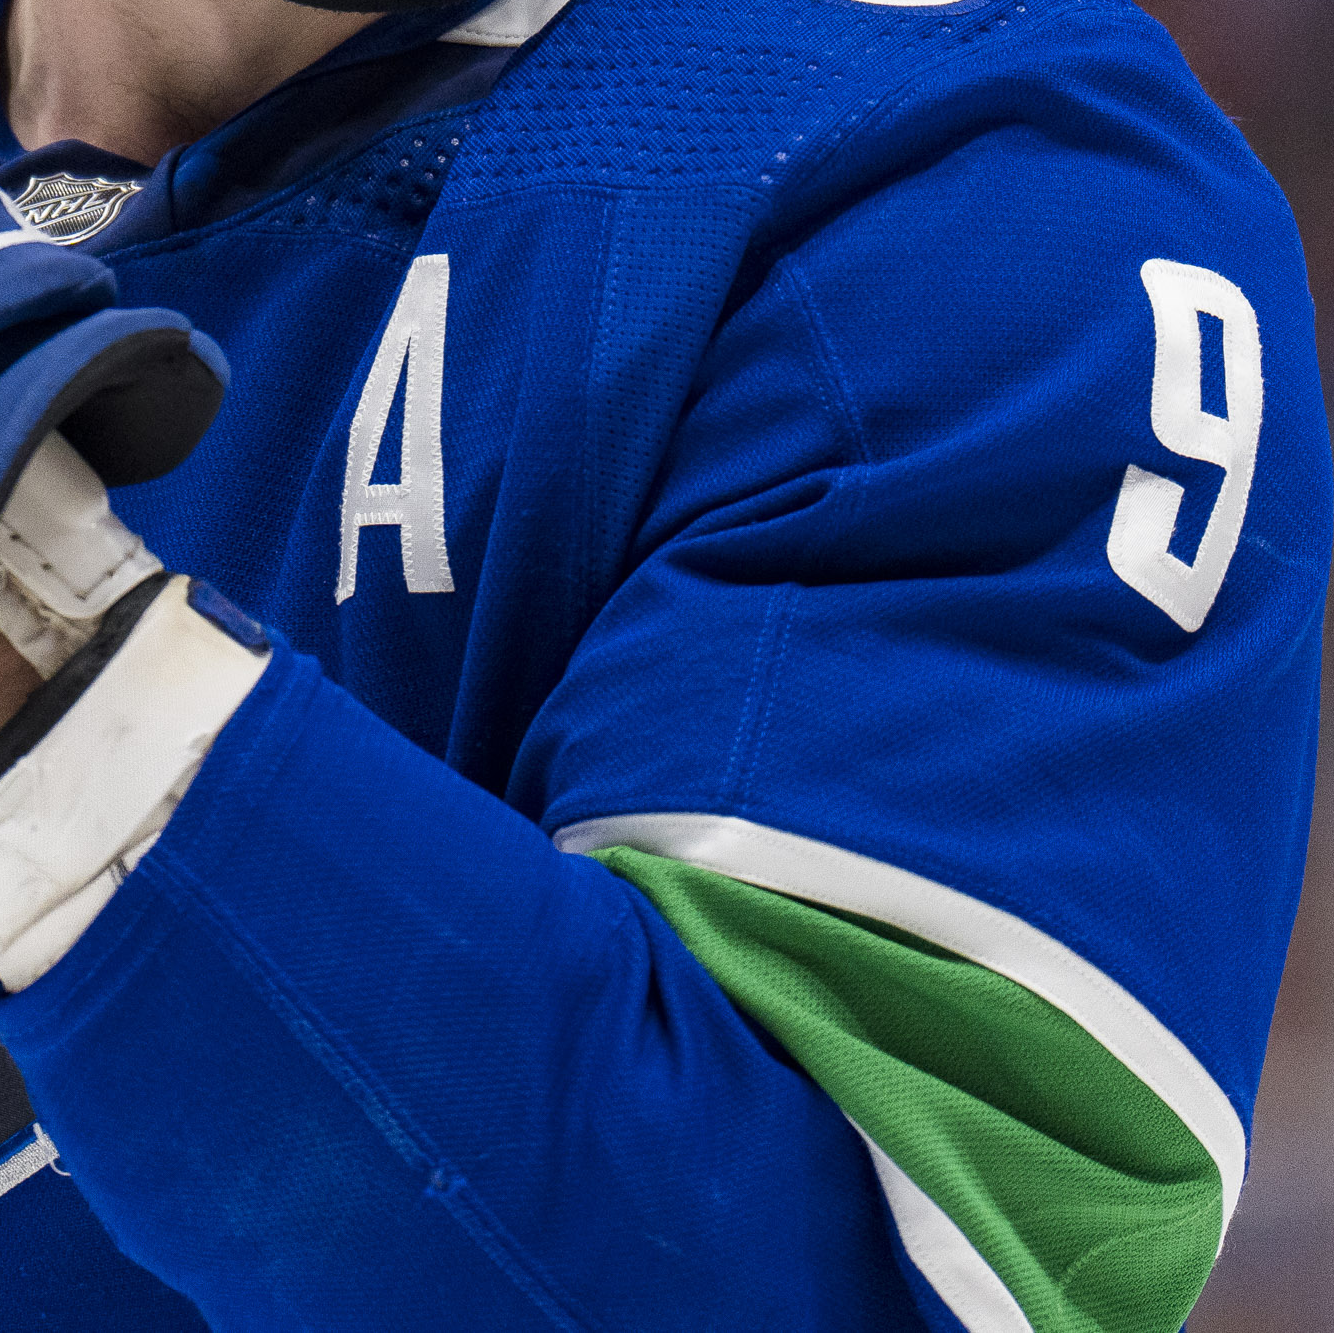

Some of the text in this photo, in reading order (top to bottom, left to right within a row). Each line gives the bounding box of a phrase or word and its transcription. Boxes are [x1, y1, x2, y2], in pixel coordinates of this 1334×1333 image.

[24, 191, 108, 224] NHL
[335, 253, 456, 607] A
[1106, 258, 1265, 633] 9
